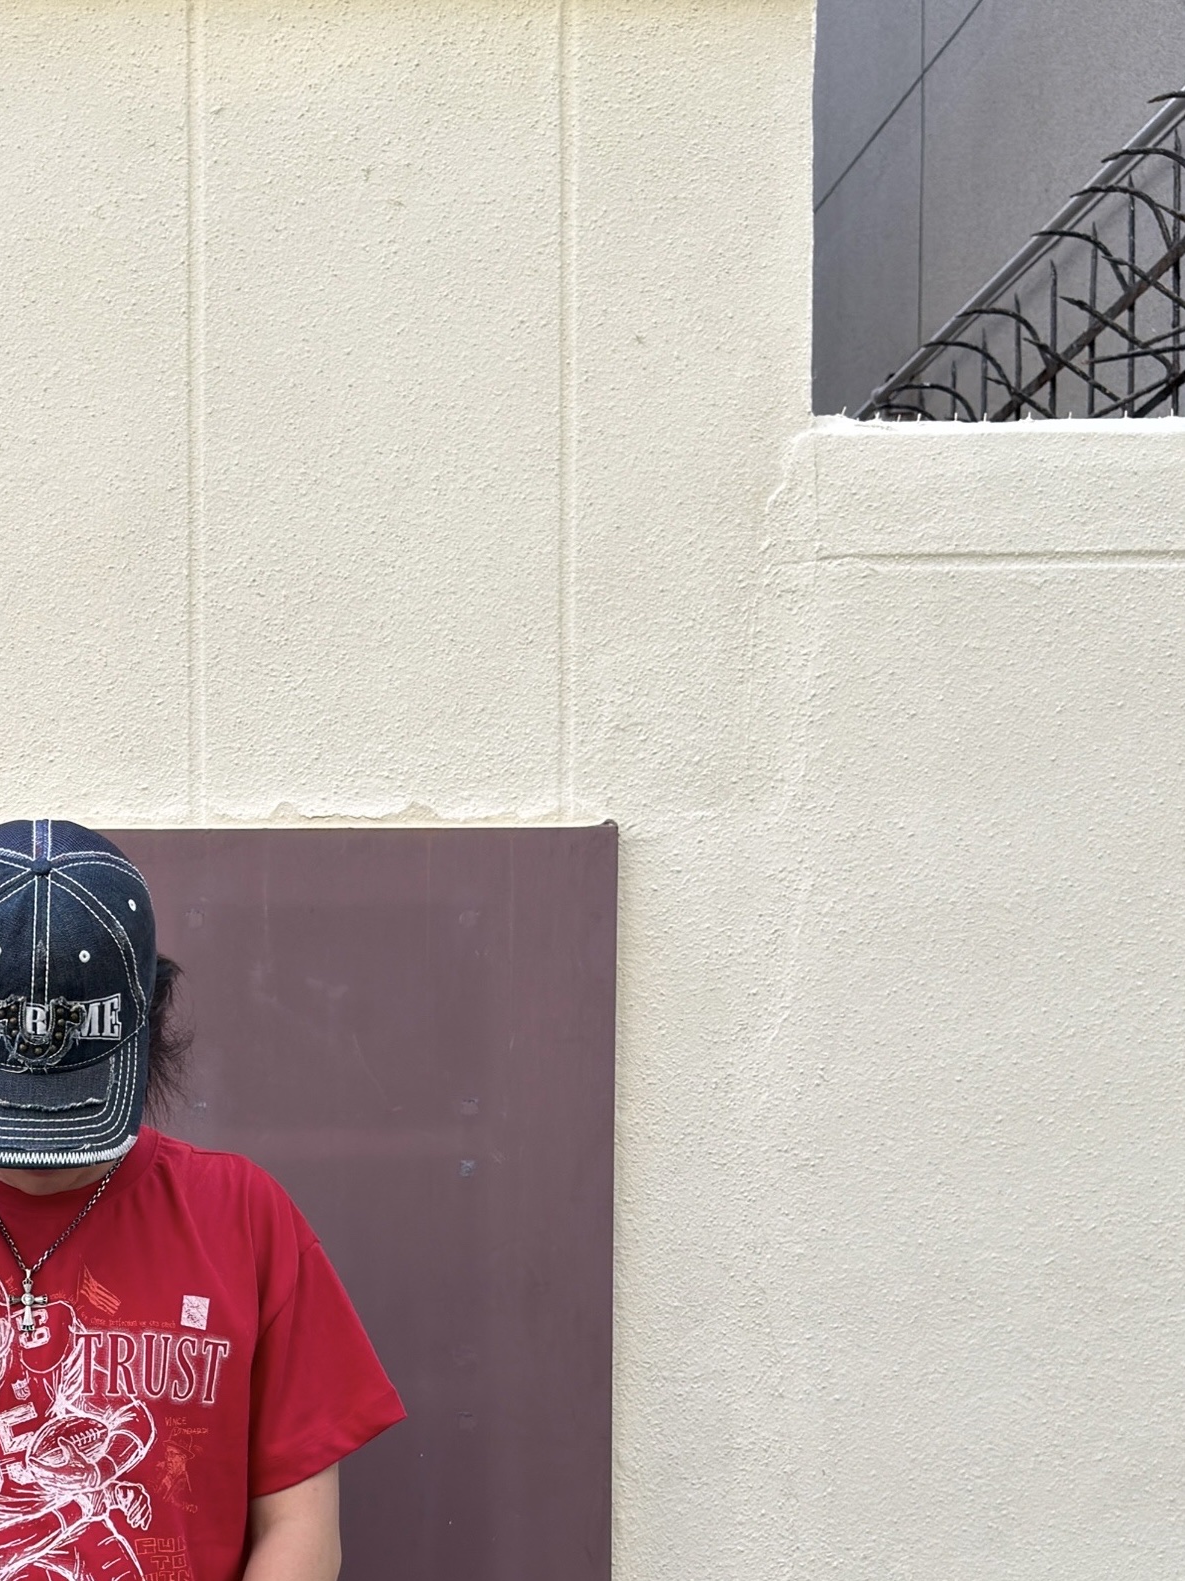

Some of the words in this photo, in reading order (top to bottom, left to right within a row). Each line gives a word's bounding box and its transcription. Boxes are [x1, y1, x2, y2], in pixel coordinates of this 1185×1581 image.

[74, 1331, 230, 1404] TRUST
[164, 1416, 187, 1427] VINCE
[150, 1553, 187, 1570] TO
